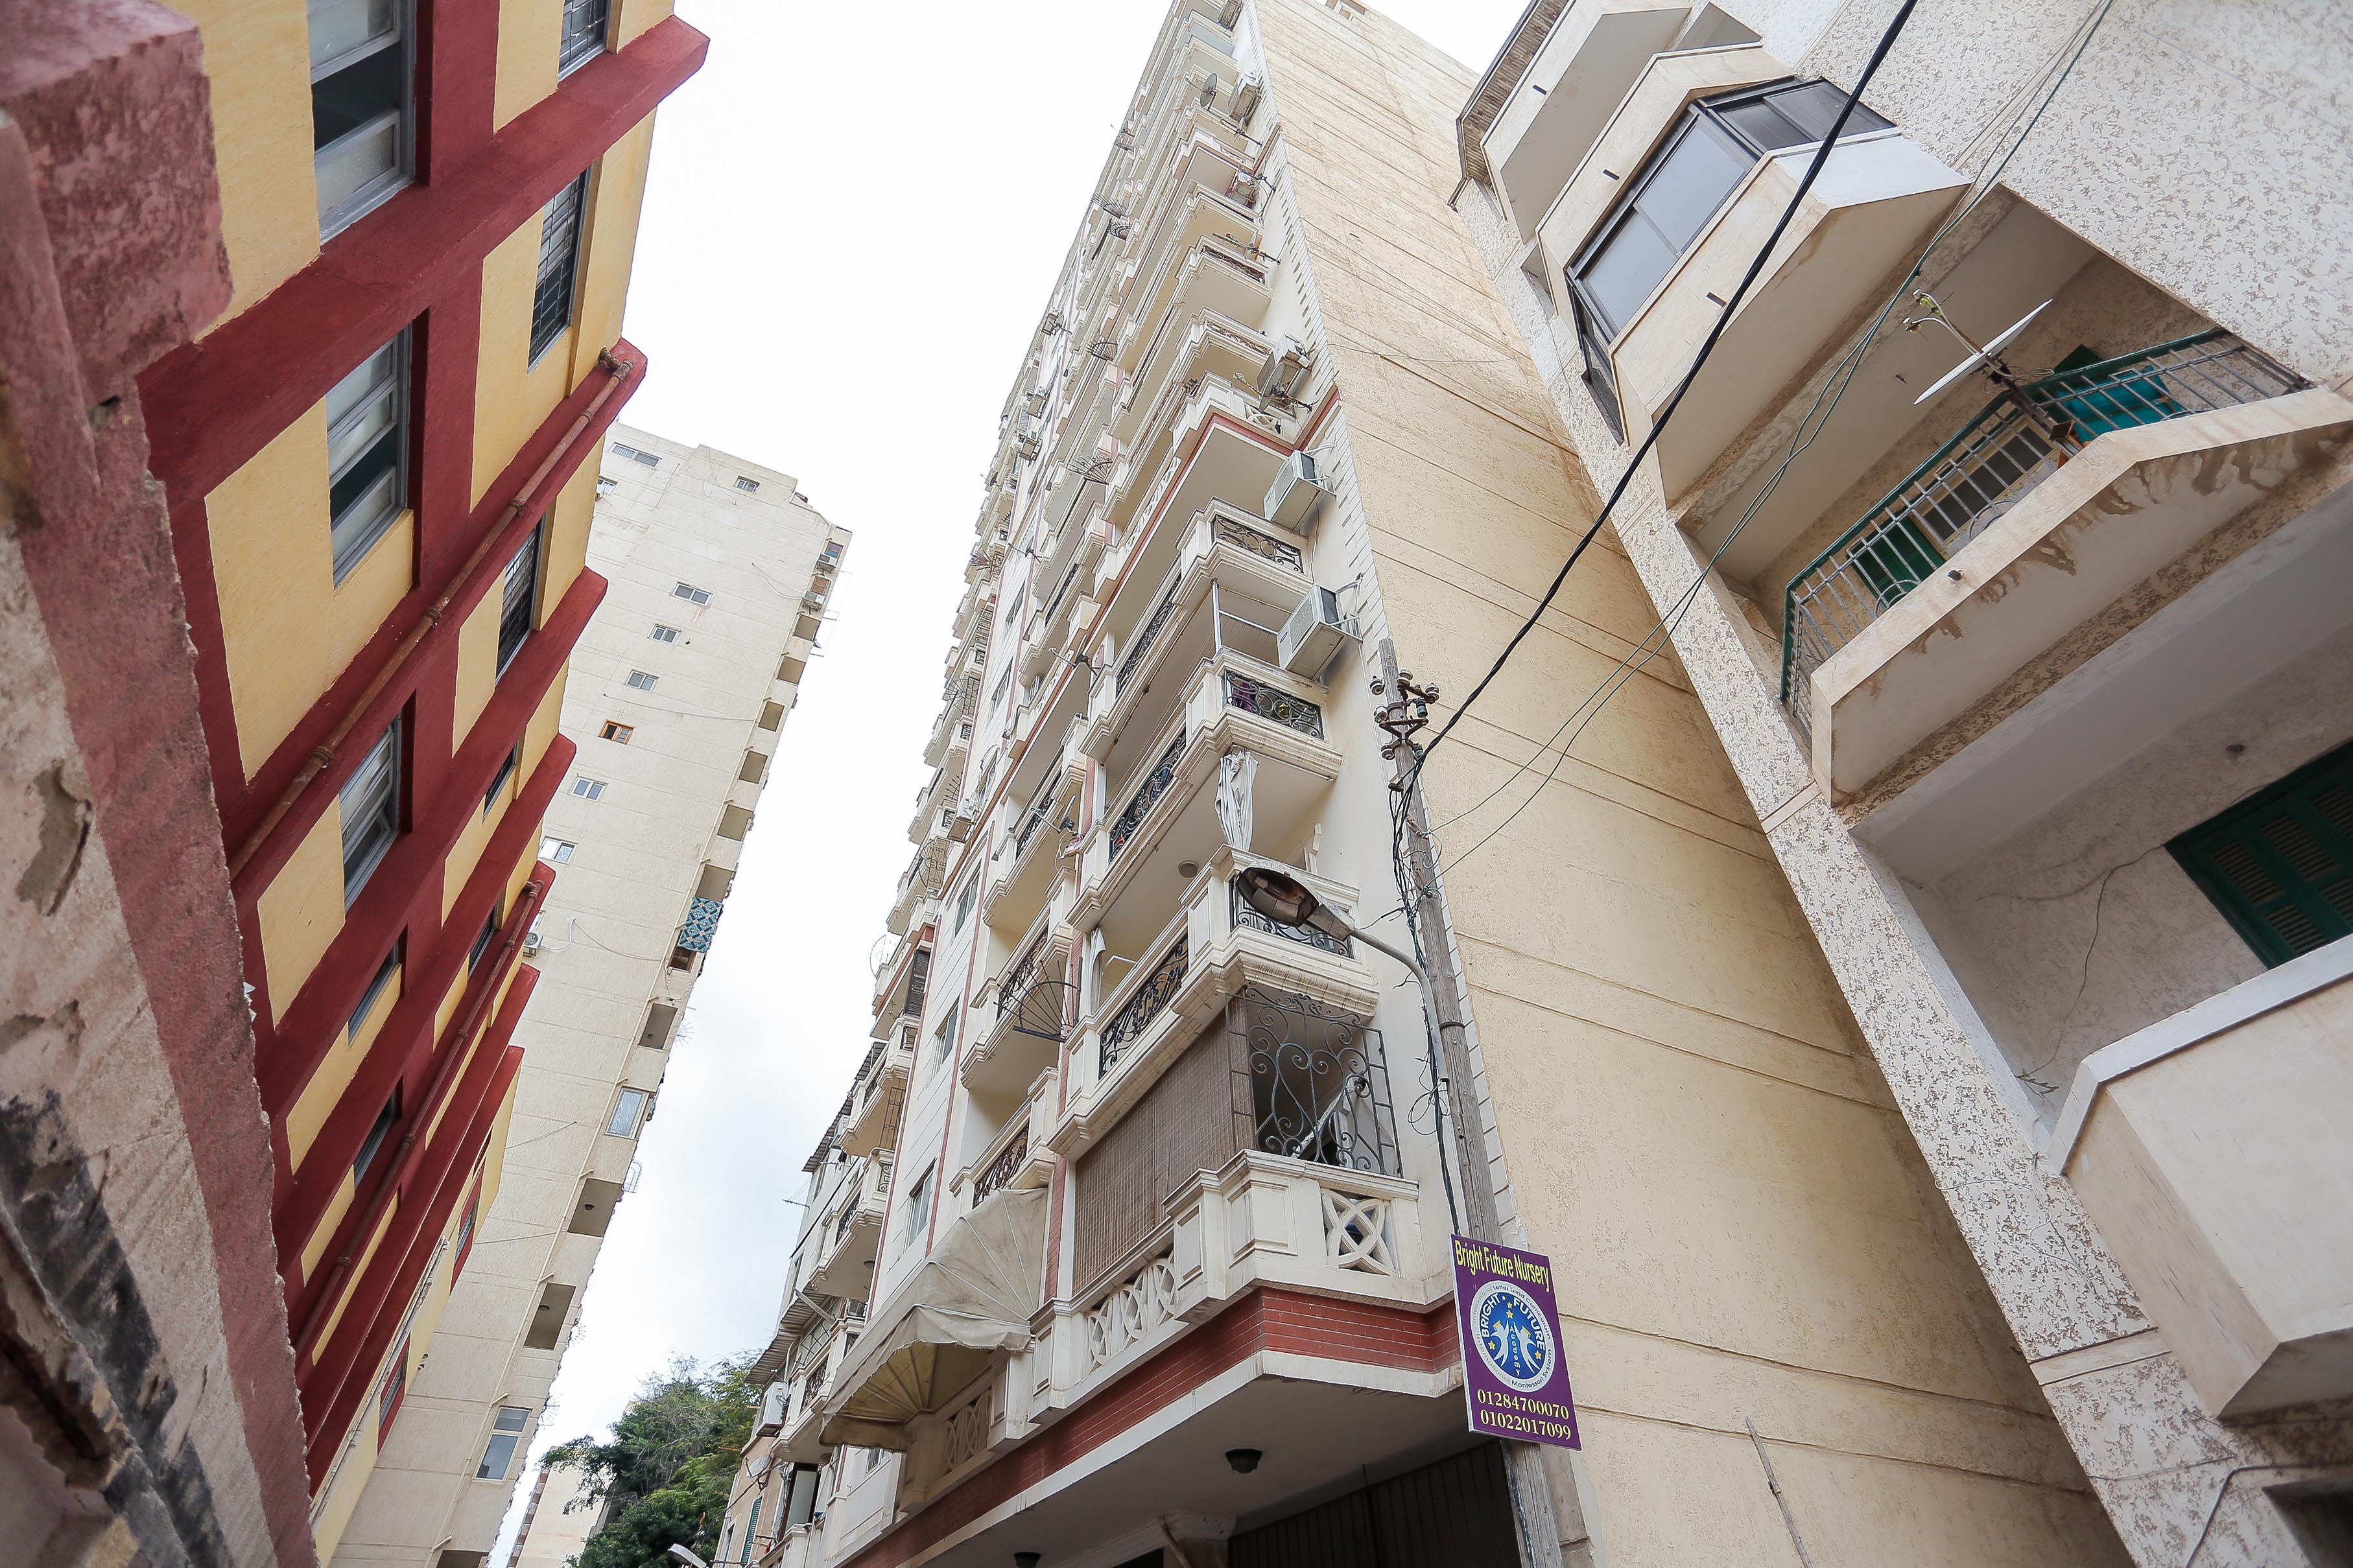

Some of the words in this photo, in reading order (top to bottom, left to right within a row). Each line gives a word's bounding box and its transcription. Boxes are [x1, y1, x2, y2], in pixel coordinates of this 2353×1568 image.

[1455, 1239, 1485, 1276] Bright
[1484, 1246, 1514, 1278] Future
[1514, 1254, 1550, 1293] Nursery
[1480, 1293, 1500, 1338] BRIGHT
[1513, 1296, 1545, 1351] FUTURE
[1510, 1287, 1525, 1299] Land
[1526, 1298, 1550, 1340] Curriculum
[1476, 1333, 1510, 1383] International
[1511, 1376, 1544, 1388] Montessori
[1509, 1326, 1520, 1376] Academy
[1477, 1388, 1569, 1420] 01284700070
[1480, 1409, 1571, 1440] 01022017099
